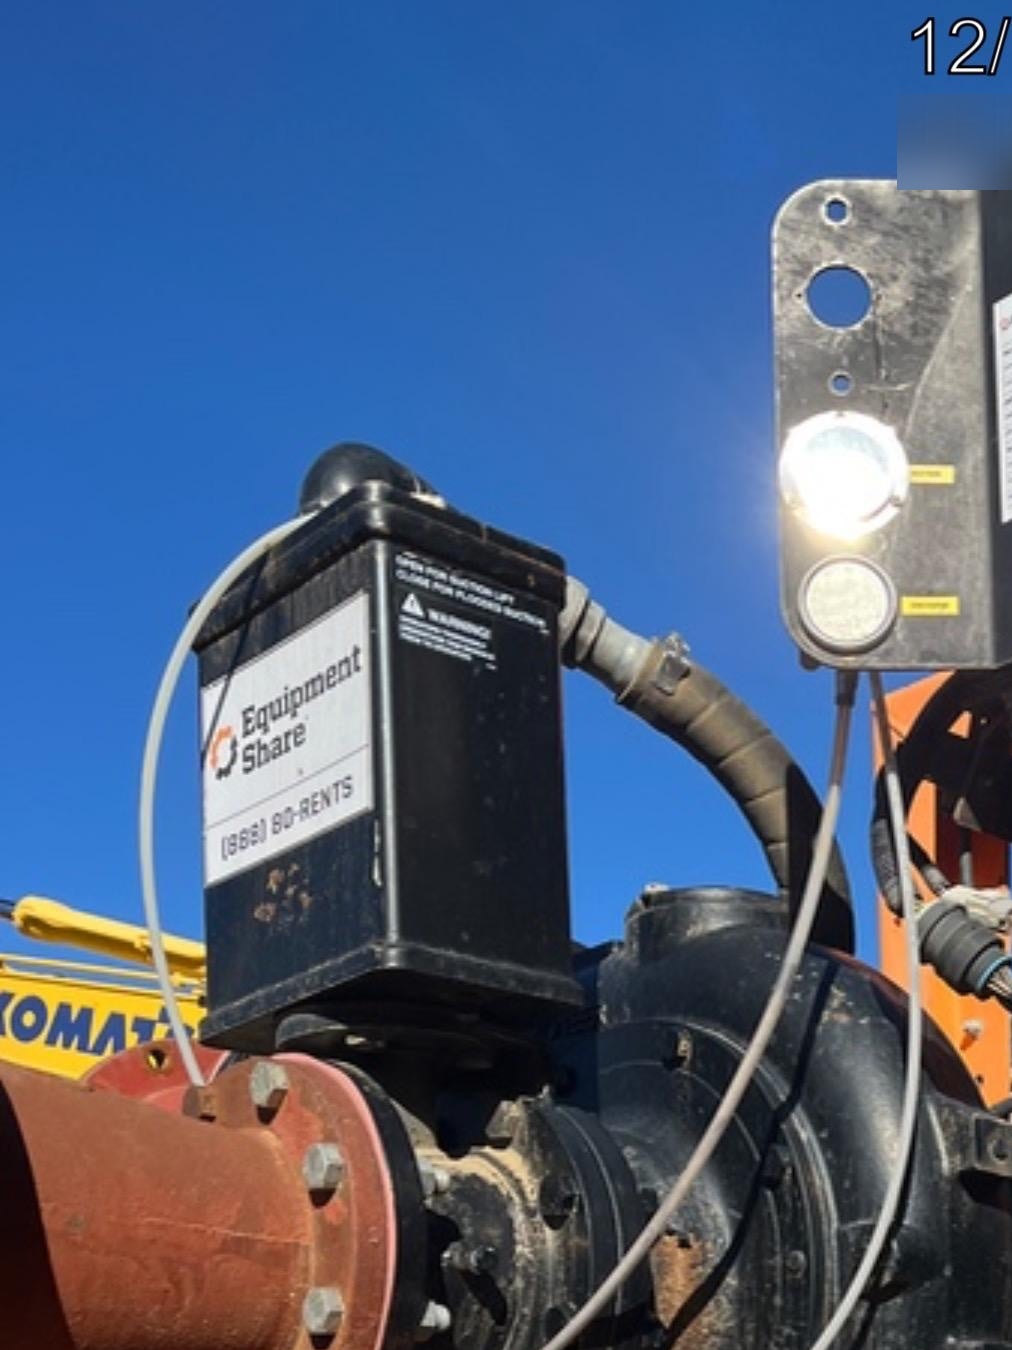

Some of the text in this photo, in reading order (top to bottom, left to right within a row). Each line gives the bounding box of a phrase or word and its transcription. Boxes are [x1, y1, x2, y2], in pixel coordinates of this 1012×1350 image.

[241, 645, 362, 739] Equipment
[241, 722, 306, 775] Share
[271, 775, 353, 835] 80-RENTS
